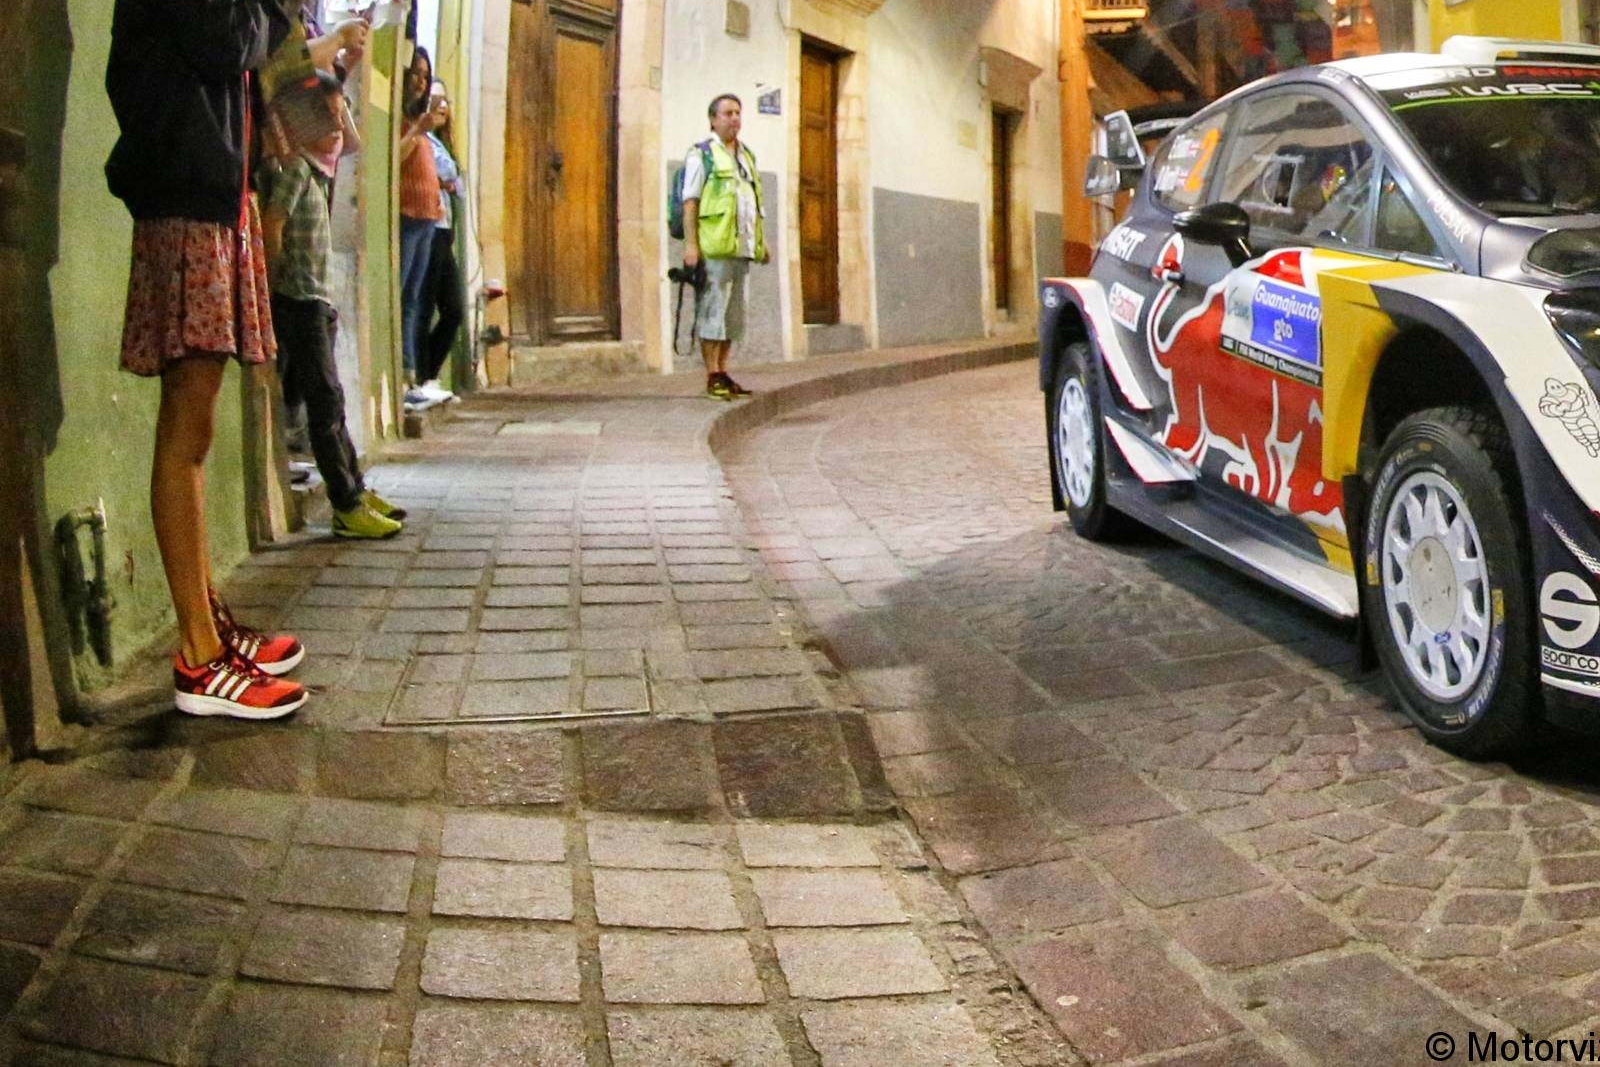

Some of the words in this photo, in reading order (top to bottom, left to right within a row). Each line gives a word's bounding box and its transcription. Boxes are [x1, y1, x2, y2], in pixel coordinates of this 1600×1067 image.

[1183, 127, 1220, 192] 2
[1254, 284, 1320, 321] Guanajuato
[1273, 318, 1294, 342] gto
[1542, 647, 1600, 671] sparco
